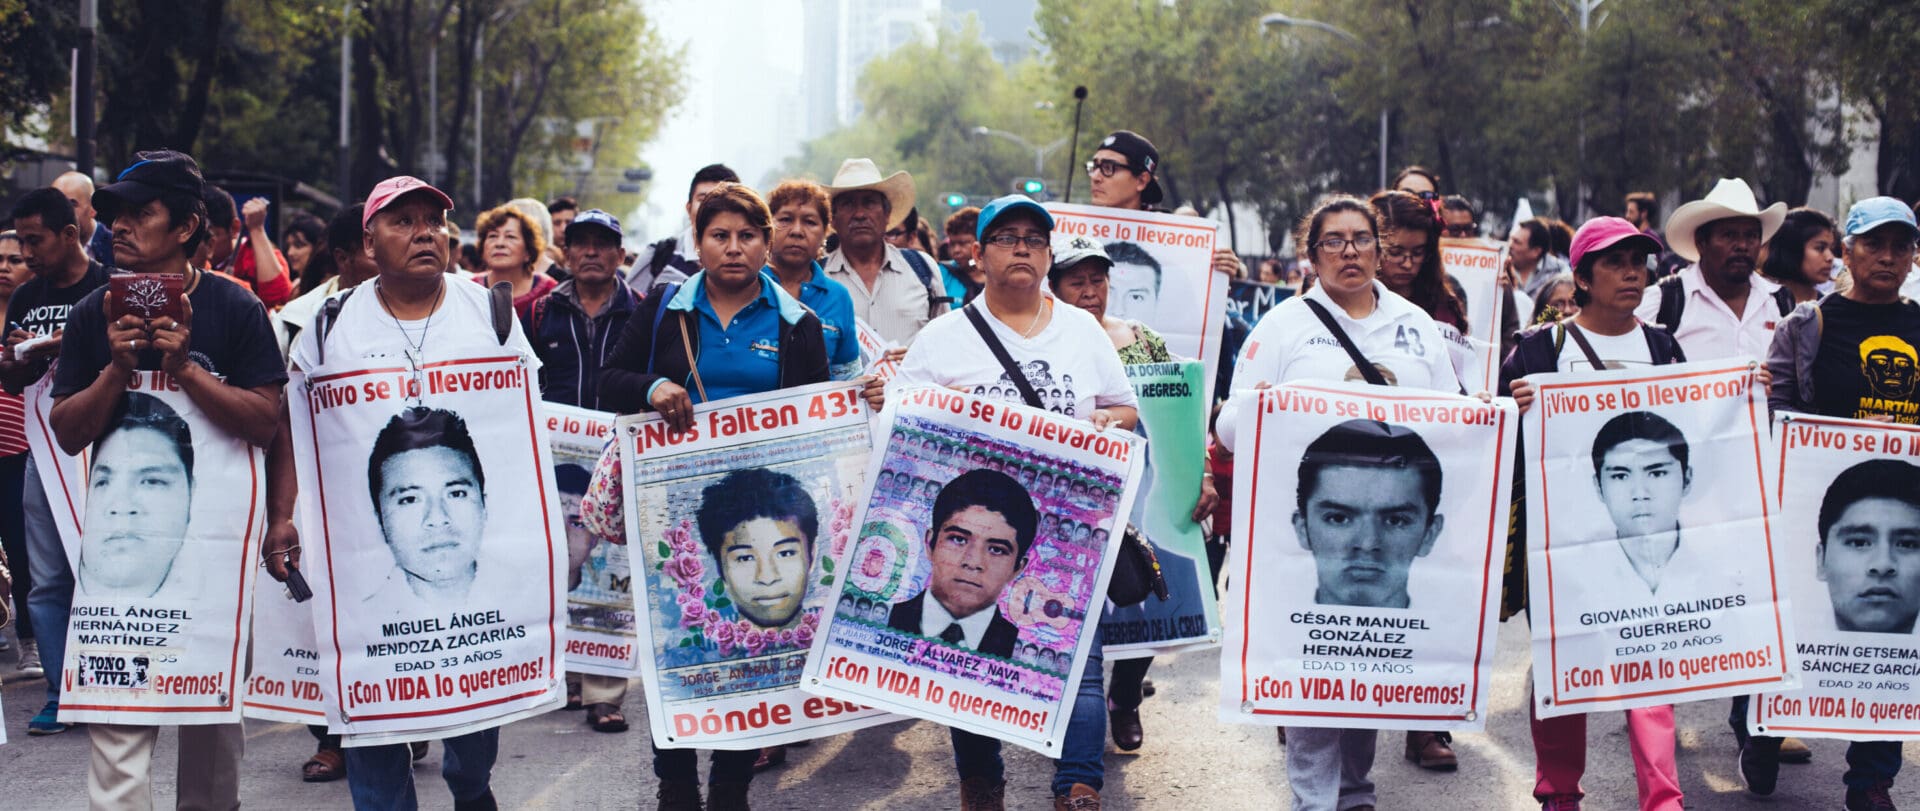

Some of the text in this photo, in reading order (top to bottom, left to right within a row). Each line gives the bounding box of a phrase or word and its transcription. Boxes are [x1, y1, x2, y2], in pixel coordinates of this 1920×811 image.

[1092, 224, 1110, 238] se
[1116, 224, 1130, 240] lo
[1136, 226, 1210, 249] llevaron!
[1394, 324, 1426, 357] 43
[1139, 363, 1185, 379] DORMIR,
[313, 365, 522, 414] ¡Vivo se lo llevaron!
[1142, 383, 1192, 398] REGRESO.
[1547, 375, 1746, 418] ¡Vivo se lo llevaron!
[708, 403, 799, 438] faltan
[807, 389, 860, 421] 43!
[1266, 390, 1496, 426] ¡Vivo se lo llevaron!
[563, 416, 580, 434] lo
[970, 400, 995, 423] se
[999, 408, 1023, 430] lo
[1027, 415, 1129, 463] llevaron!
[1790, 424, 1847, 450] ¡Vivo
[1853, 433, 1876, 452] se
[1882, 432, 1902, 455] lo
[125, 606, 192, 620] ÁNGEL
[1290, 611, 1430, 630] CÉSAR MANUEL
[1580, 594, 1746, 625] GIOVANNI GALINDES
[73, 619, 180, 634] HERNÁNDEZ
[382, 610, 505, 637] MIGUEL ÁNGEL
[1179, 614, 1206, 638] CRUZ
[1619, 617, 1712, 640] GUERRERO
[78, 634, 168, 647] MARTÍNEZ
[367, 625, 526, 658] MENDOZA ZACARIAS
[1308, 629, 1406, 644] GONZÁLEZ
[1615, 634, 1723, 657] EDAD 20 AÑOS
[395, 649, 503, 672] EDAD 33 AÑOS
[873, 633, 916, 655] JORGE
[987, 662, 1020, 683] NAVA
[1302, 643, 1413, 659] HERNÁNDEZ
[94, 671, 130, 686] VIVE
[1303, 660, 1414, 674] EDAD 19 AÑOS
[1564, 645, 1773, 692] ¡Con VIDA lo queremos!
[1801, 659, 1870, 674] SÁNCHEZ
[248, 675, 285, 696] ¡Con
[348, 656, 544, 708] ¡Con VIDA lo queremos!
[679, 671, 720, 687] JORGE
[1254, 675, 1466, 707] ¡Con VIDA lo queremos!
[1818, 680, 1910, 691] EDAD 20 AÑOS
[826, 656, 1048, 733] ¡Con VIDA lo queremos!
[1767, 694, 1802, 719] ¡Con
[1808, 696, 1846, 718] VIDA
[1851, 697, 1865, 719] lo
[673, 701, 792, 737] Dónde
